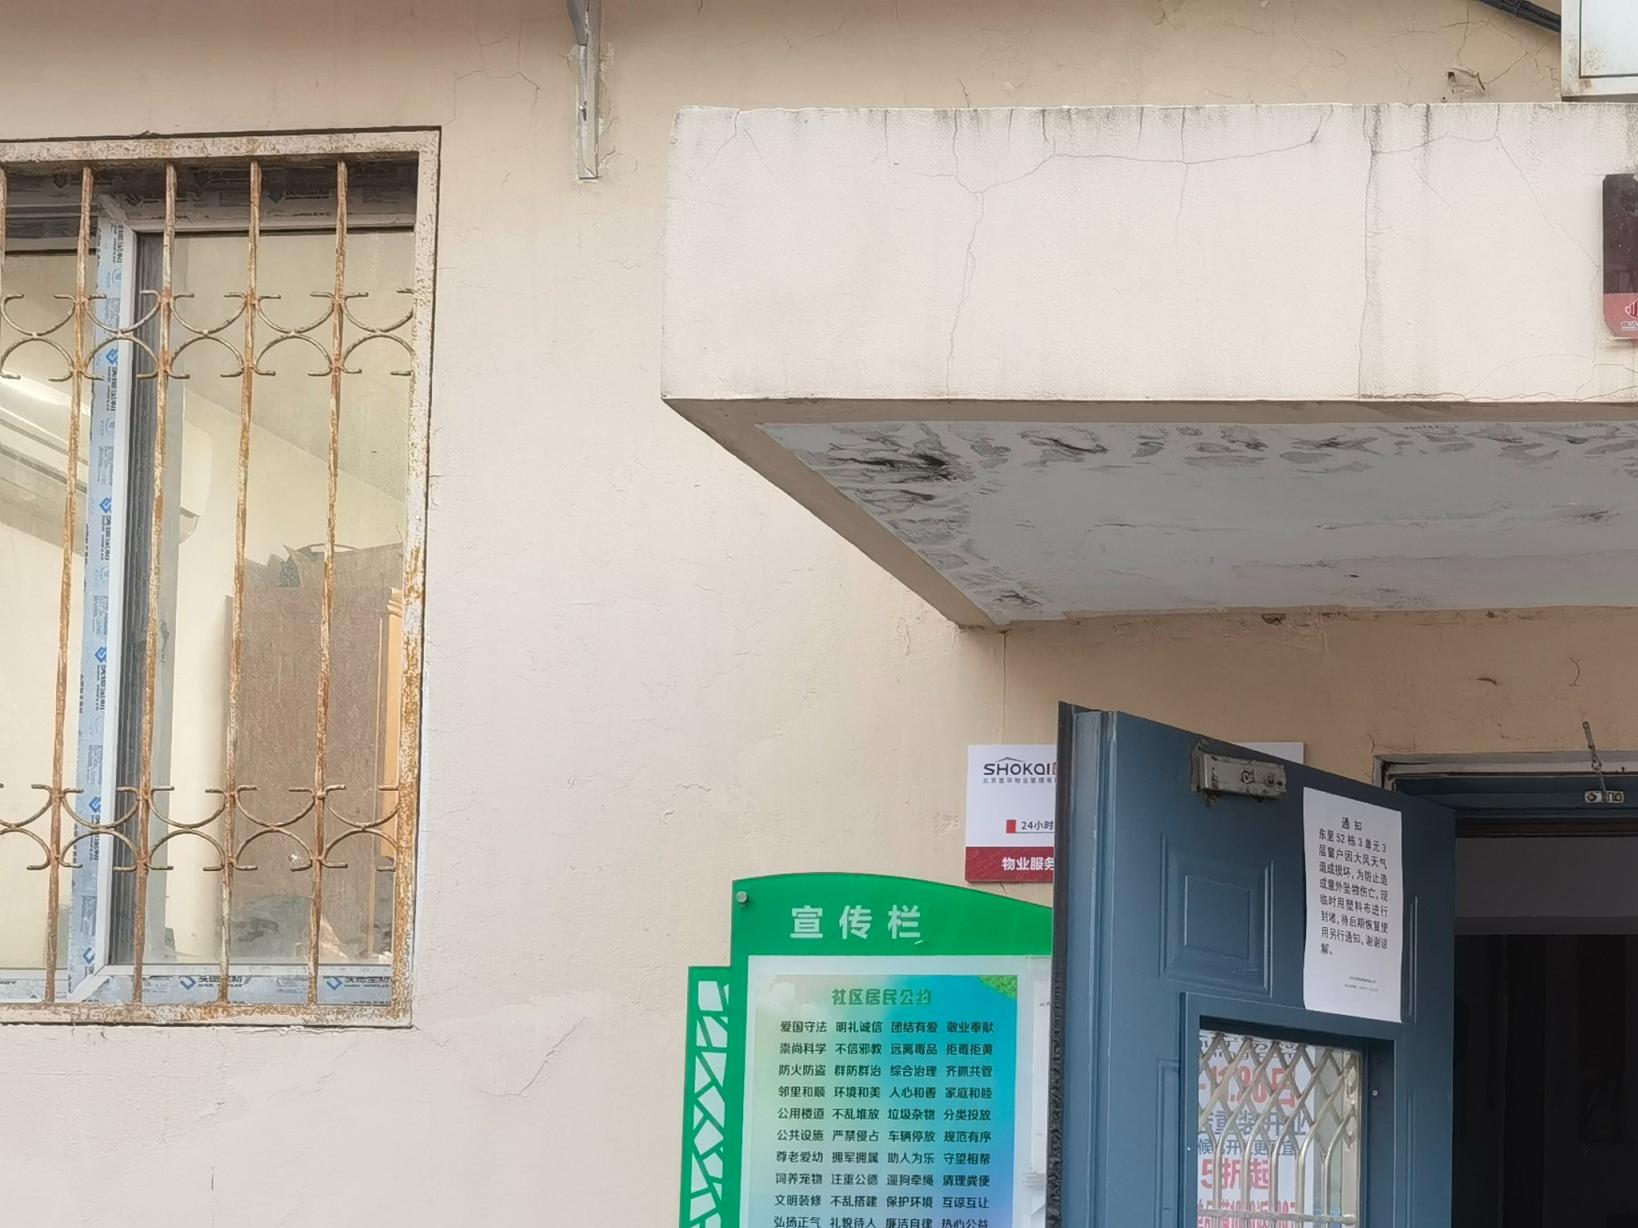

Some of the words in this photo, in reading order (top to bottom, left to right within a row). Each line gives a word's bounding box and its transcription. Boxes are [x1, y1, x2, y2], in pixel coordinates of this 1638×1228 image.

[1341, 816, 1362, 831] 通知
[1001, 856, 1055, 871] 物业服务
[1318, 844, 1387, 870] 层窗户因大风天气
[1320, 893, 1388, 918] 临时用塑料布进行
[790, 904, 921, 940] 宣传栏
[831, 988, 932, 1006] 社区居民公约
[780, 1020, 827, 1033] 爱国守法
[835, 1020, 882, 1033] 明礼诚信
[946, 1021, 994, 1033] 敬业奉献
[779, 1043, 827, 1055] 崇尚科学
[835, 1043, 882, 1055] 不信邪教
[891, 1043, 938, 1055] 远离毒品
[946, 1043, 993, 1056] 拒毒拒黄
[778, 1064, 826, 1076] 防火防盗
[834, 1064, 881, 1077] 群防群治
[890, 1065, 937, 1077] 综合治理
[945, 1065, 993, 1077] 齐抓共管
[778, 1086, 826, 1098] 邻里和顺
[834, 1086, 881, 1098] 环境和美
[889, 1087, 937, 1099] 人心和善
[944, 1087, 992, 1099] 家庭和睦
[778, 1107, 825, 1120] 公用楼道
[832, 1108, 880, 1120] 不乱堆放
[888, 1108, 935, 1120] 垃圾杂物
[944, 1109, 991, 1121] 分类投放
[777, 1129, 824, 1141] 公共设施
[832, 1130, 879, 1142] 严禁侵占
[888, 1130, 936, 1142] 车辆停放
[944, 1131, 992, 1143] 规范有序
[776, 1151, 823, 1163] 尊老爱幼
[832, 1151, 879, 1164] 拥军拥属
[888, 1152, 935, 1164] 助人为乐
[775, 1172, 823, 1185] 饲养宠物
[831, 1173, 878, 1185] 注重公德
[774, 1194, 821, 1207] 文明装修
[830, 1195, 877, 1207] 不乱搭建
[886, 1196, 933, 1208] 保护环境
[942, 1196, 990, 1209] 互谅互让
[774, 1216, 821, 1228] 弘扬正气
[830, 1217, 877, 1228] 礼貌待人
